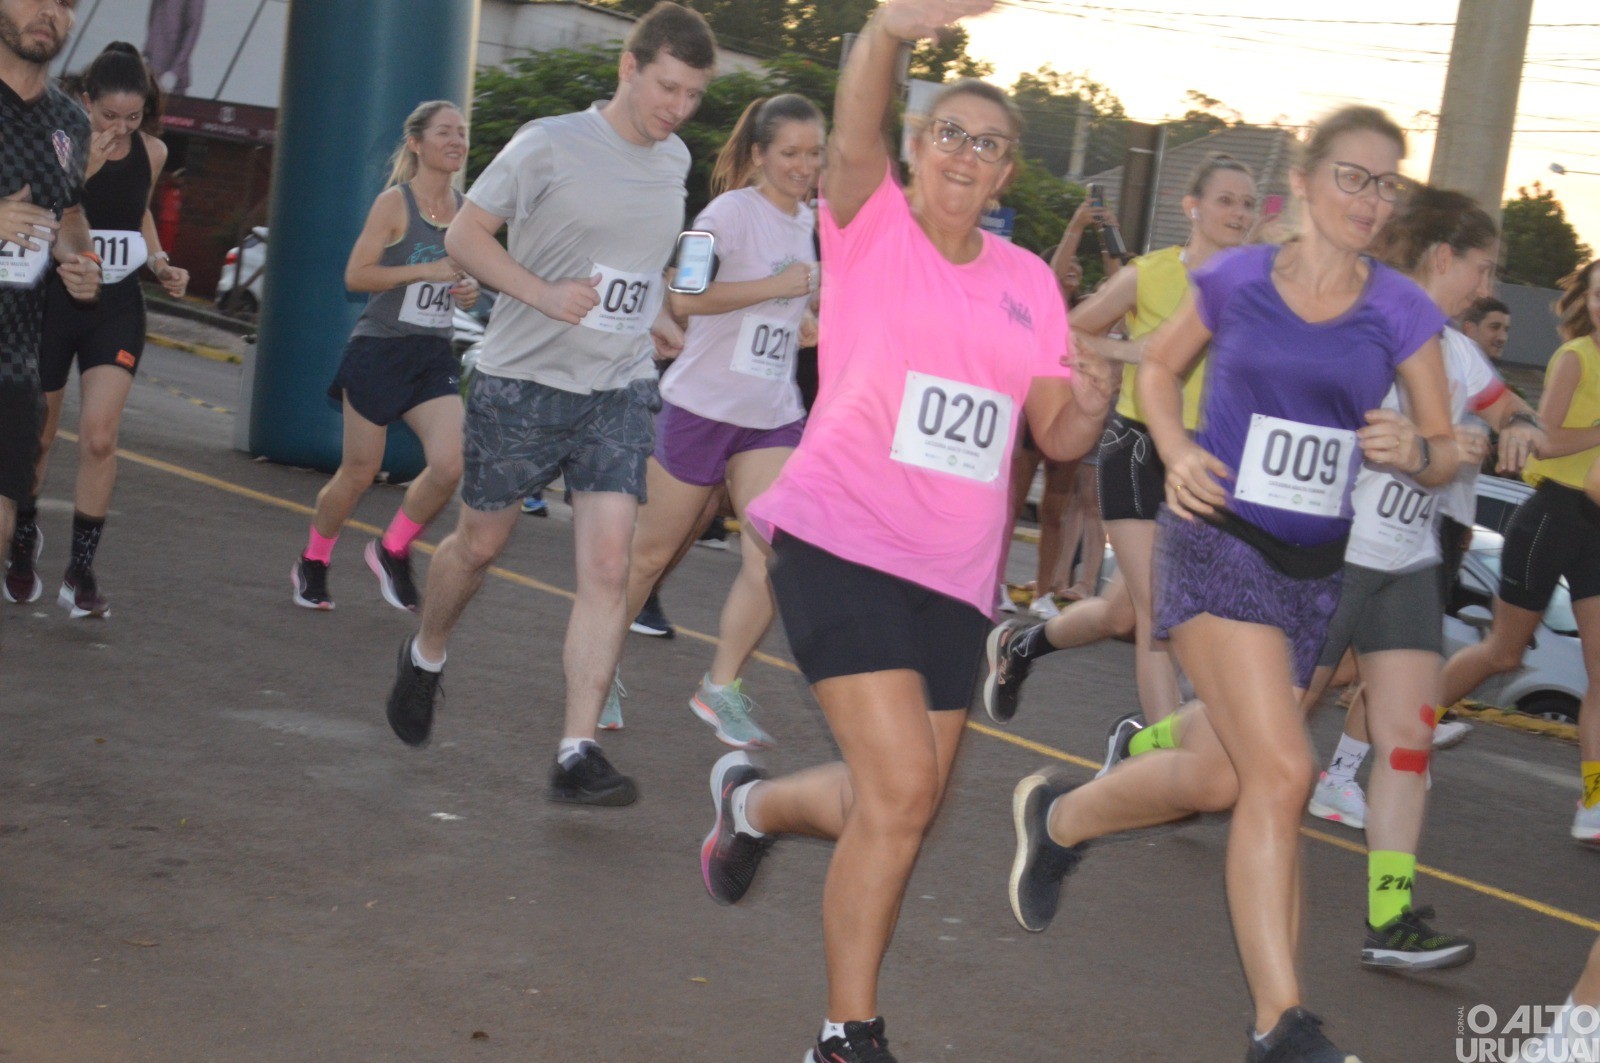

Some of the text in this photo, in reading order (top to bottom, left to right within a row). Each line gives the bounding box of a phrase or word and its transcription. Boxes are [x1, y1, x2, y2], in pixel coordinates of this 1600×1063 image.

[93, 236, 128, 265] 011
[603, 278, 650, 313] 031
[751, 324, 790, 362] 021
[917, 386, 998, 448] 020
[1262, 428, 1341, 485] 009
[1377, 480, 1433, 527] 004
